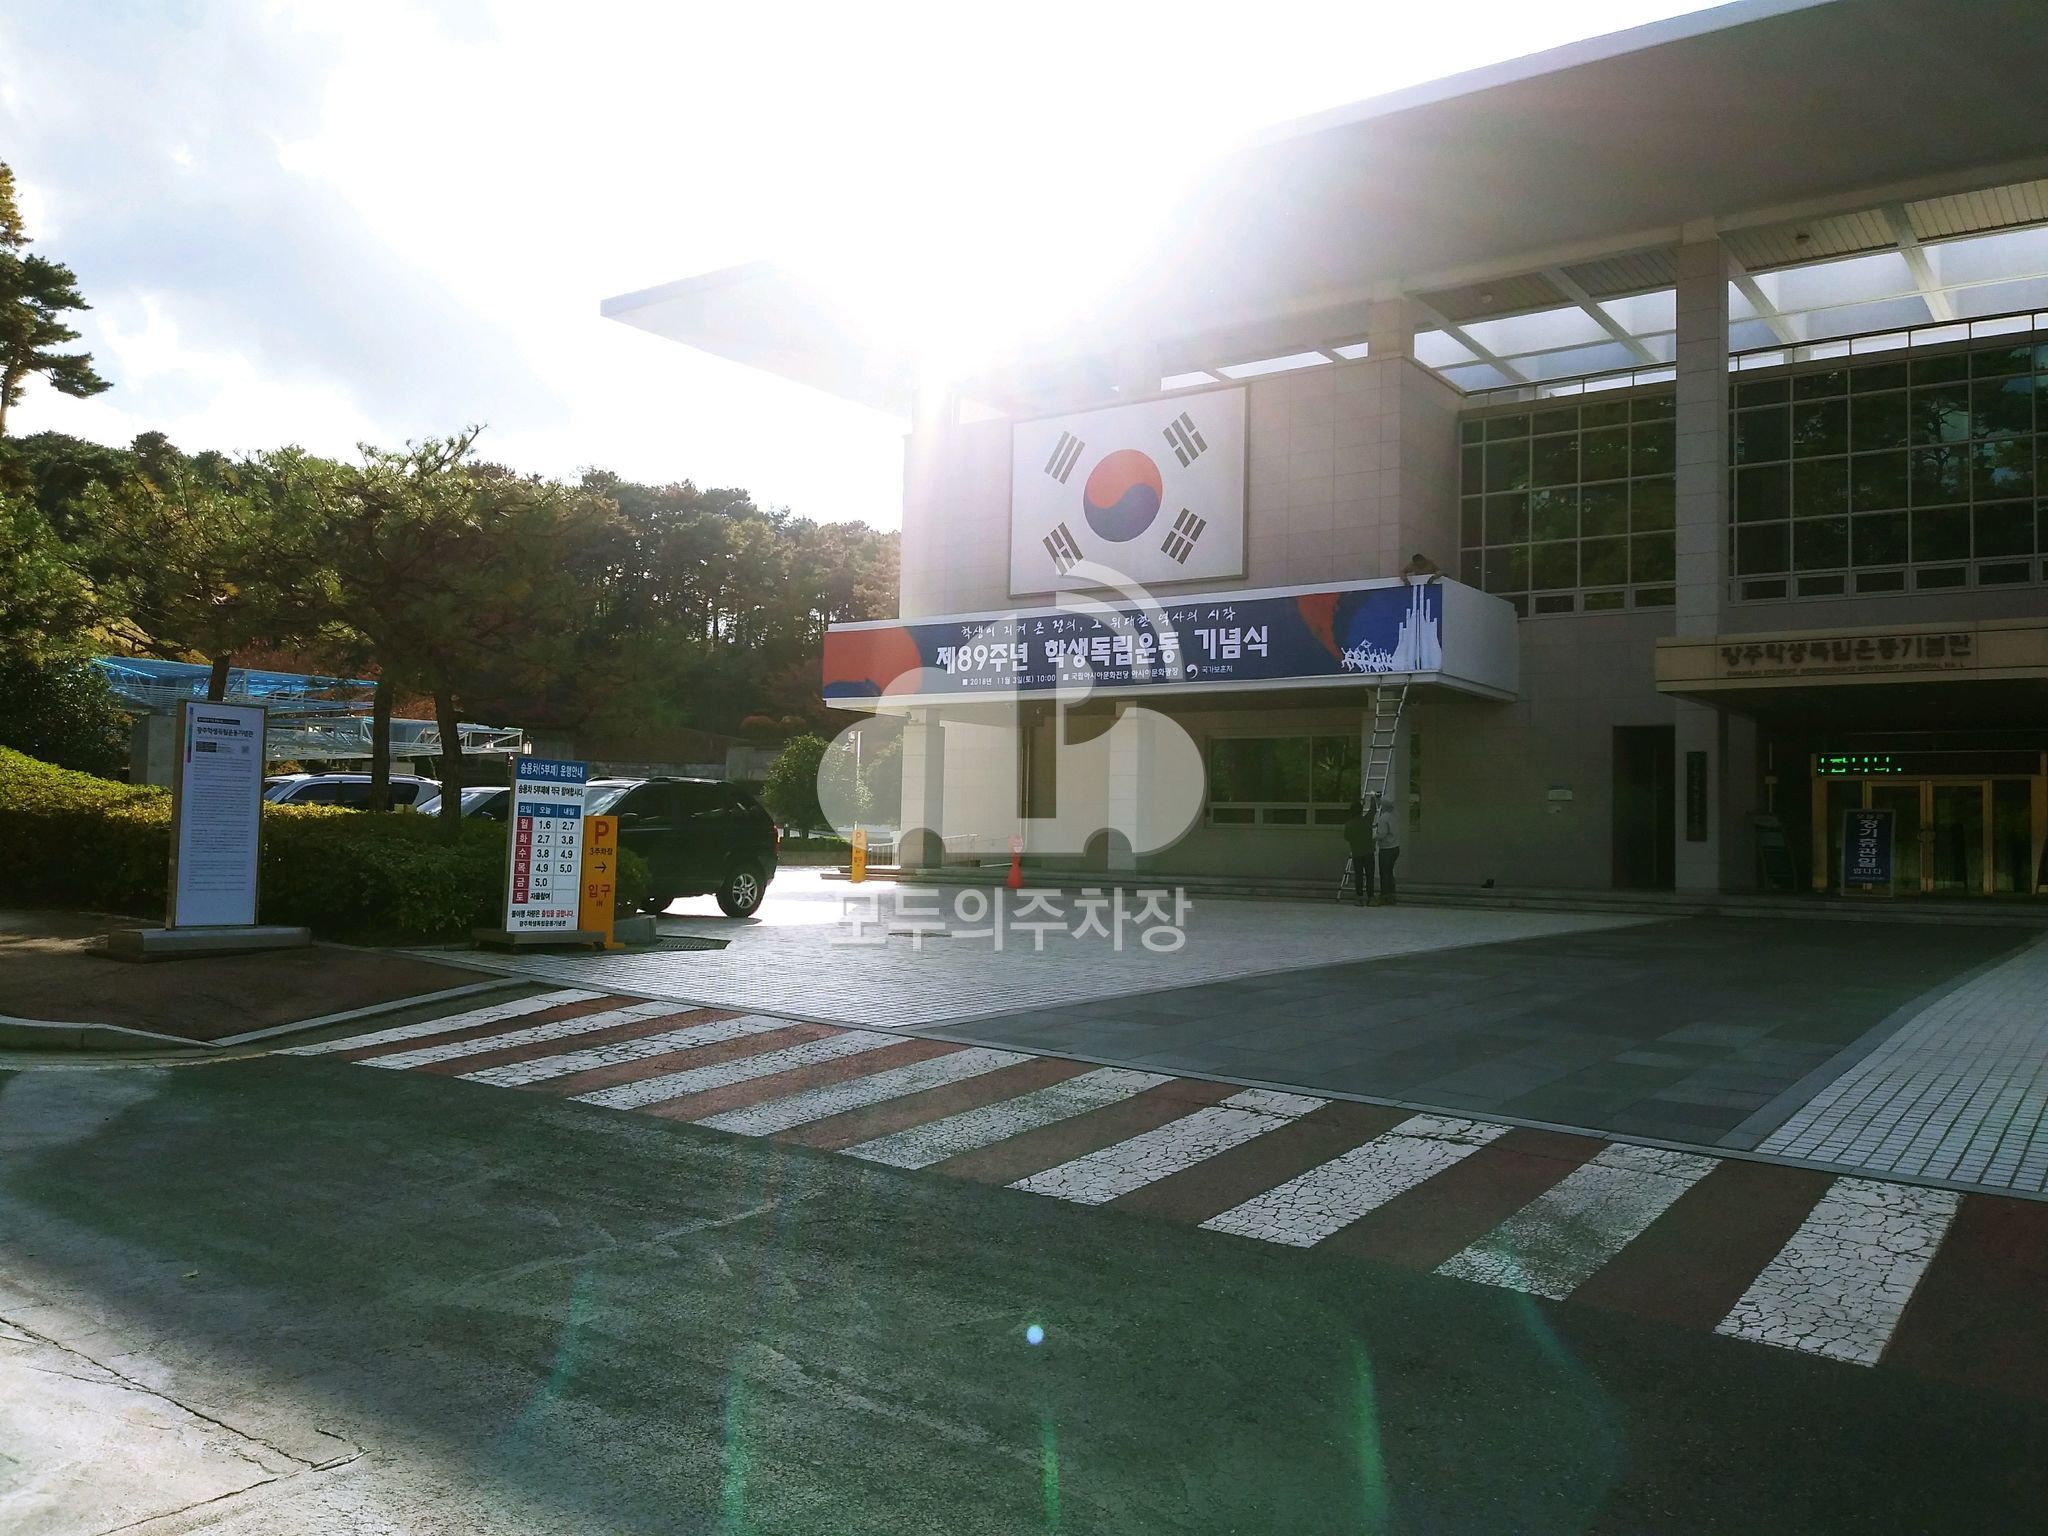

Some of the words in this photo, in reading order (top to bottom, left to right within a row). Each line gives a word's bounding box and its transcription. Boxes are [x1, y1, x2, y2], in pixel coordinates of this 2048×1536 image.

[961, 624, 995, 639] 학생이
[1004, 623, 1027, 636] 지켜
[1034, 620, 1045, 635] 온
[1052, 618, 1083, 634] 정의,
[1091, 618, 1102, 629] 그
[1110, 613, 1150, 629] 위대한
[1158, 609, 1198, 626] 역사의
[1207, 606, 1236, 622] 시작
[936, 642, 1028, 675] 제89주년
[1045, 631, 1180, 669] 학생독립운동
[1194, 625, 1268, 660] 기념식
[1201, 665, 1233, 673] 국가보훈처
[1036, 674, 1056, 682] 10:00
[1071, 671, 1129, 681] 국립아시아문화전당
[520, 762, 559, 777] 승용차(5부제)
[520, 804, 532, 814] 요일
[539, 806, 551, 815] 오늘
[563, 807, 575, 816] 내일
[521, 818, 529, 830] 월
[539, 820, 551, 829] 1.6
[562, 821, 575, 830] 2.7
[595, 821, 609, 845] P
[519, 834, 528, 843] 화
[537, 835, 550, 844] 2.7
[561, 836, 574, 845] 3.8
[518, 848, 527, 858] 수
[536, 849, 550, 858] 3.8
[560, 850, 573, 859] 4.9
[535, 864, 549, 873] 4.9
[559, 864, 572, 873] 5.0
[516, 877, 525, 887] 금
[534, 878, 548, 887] 5.0
[588, 884, 611, 898] 입구
[515, 891, 524, 901] 토
